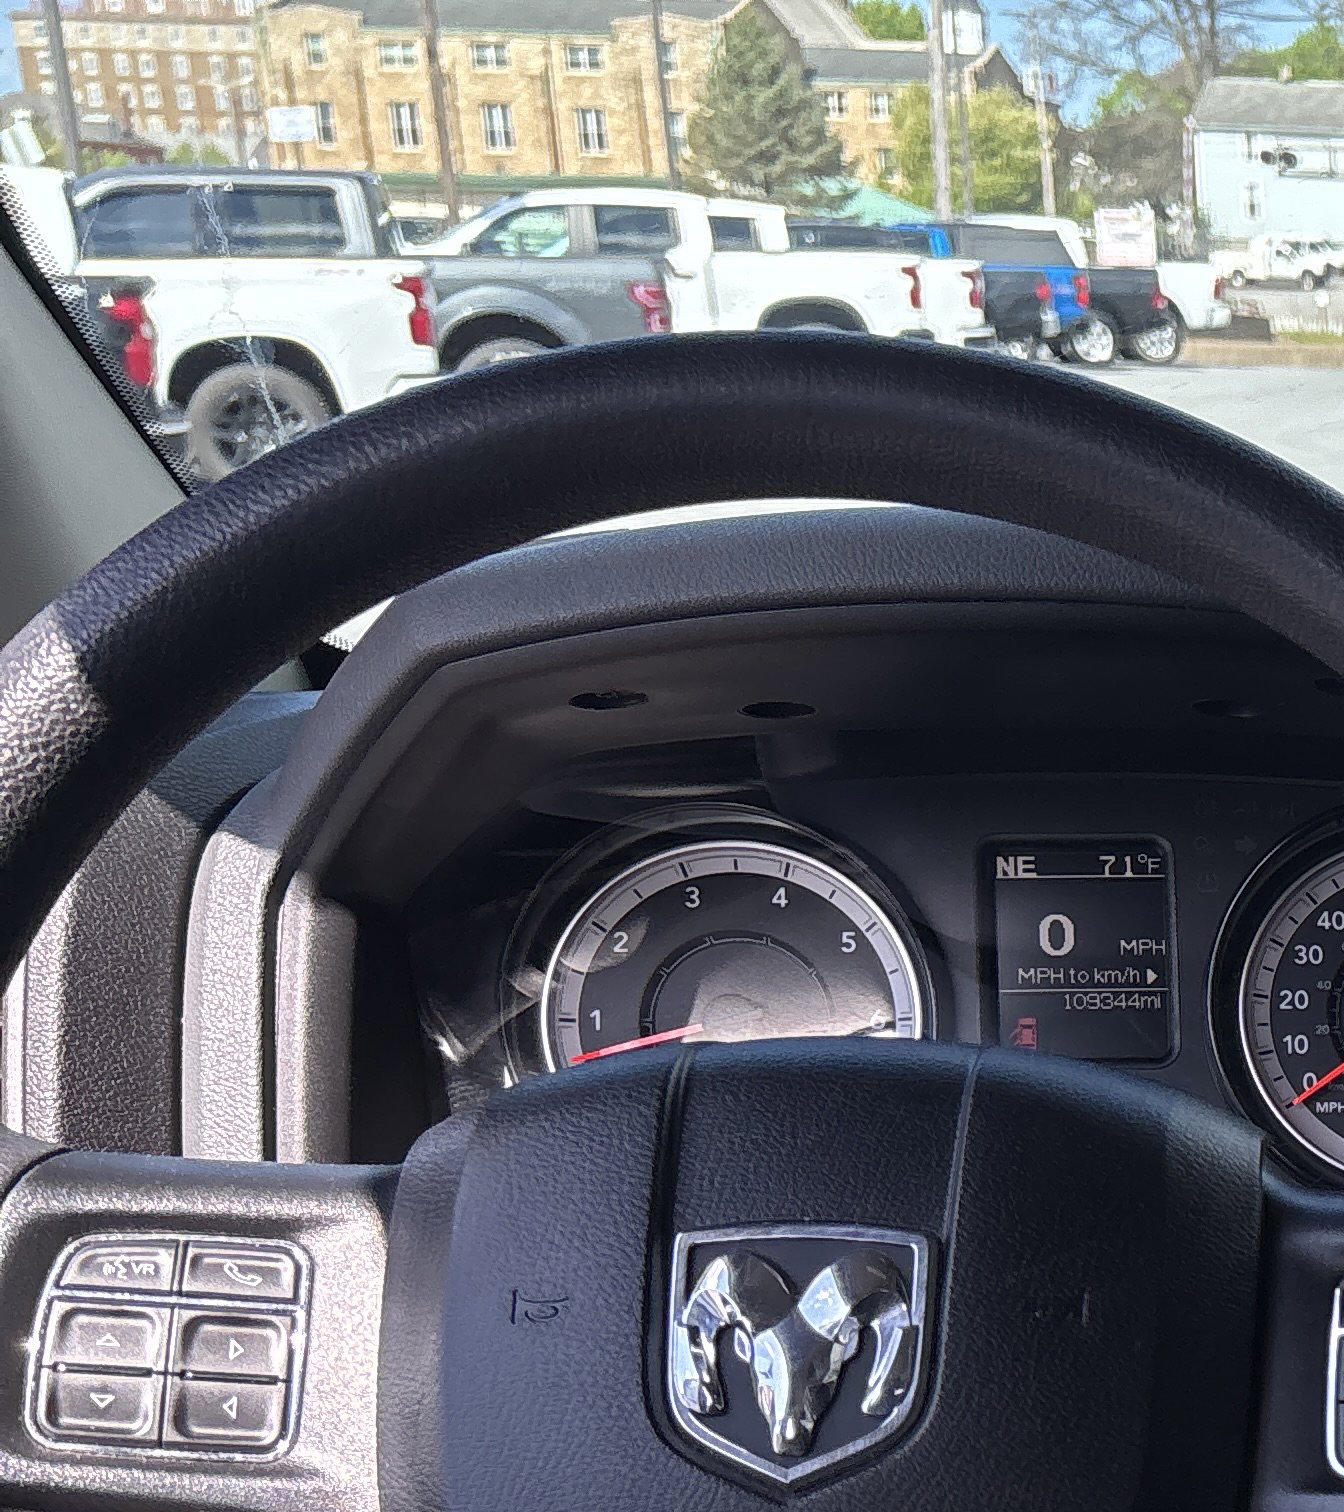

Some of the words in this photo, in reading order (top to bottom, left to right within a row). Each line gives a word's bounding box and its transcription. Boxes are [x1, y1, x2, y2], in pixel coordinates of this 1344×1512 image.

[996, 855, 1037, 877] NE
[683, 886, 701, 910] 3
[770, 886, 789, 909] 4
[612, 931, 630, 954] 2
[840, 931, 857, 954] 5
[1038, 914, 1075, 957] 0
[1120, 939, 1166, 956] MPH
[1293, 944, 1324, 965] 30
[1017, 967, 1065, 985] MPH
[1069, 968, 1090, 984] to
[1093, 967, 1141, 985] km/h
[1278, 989, 1309, 1010] 20
[589, 1009, 601, 1032] 1
[1282, 1035, 1309, 1056] 10
[132, 1262, 155, 1276] VR
